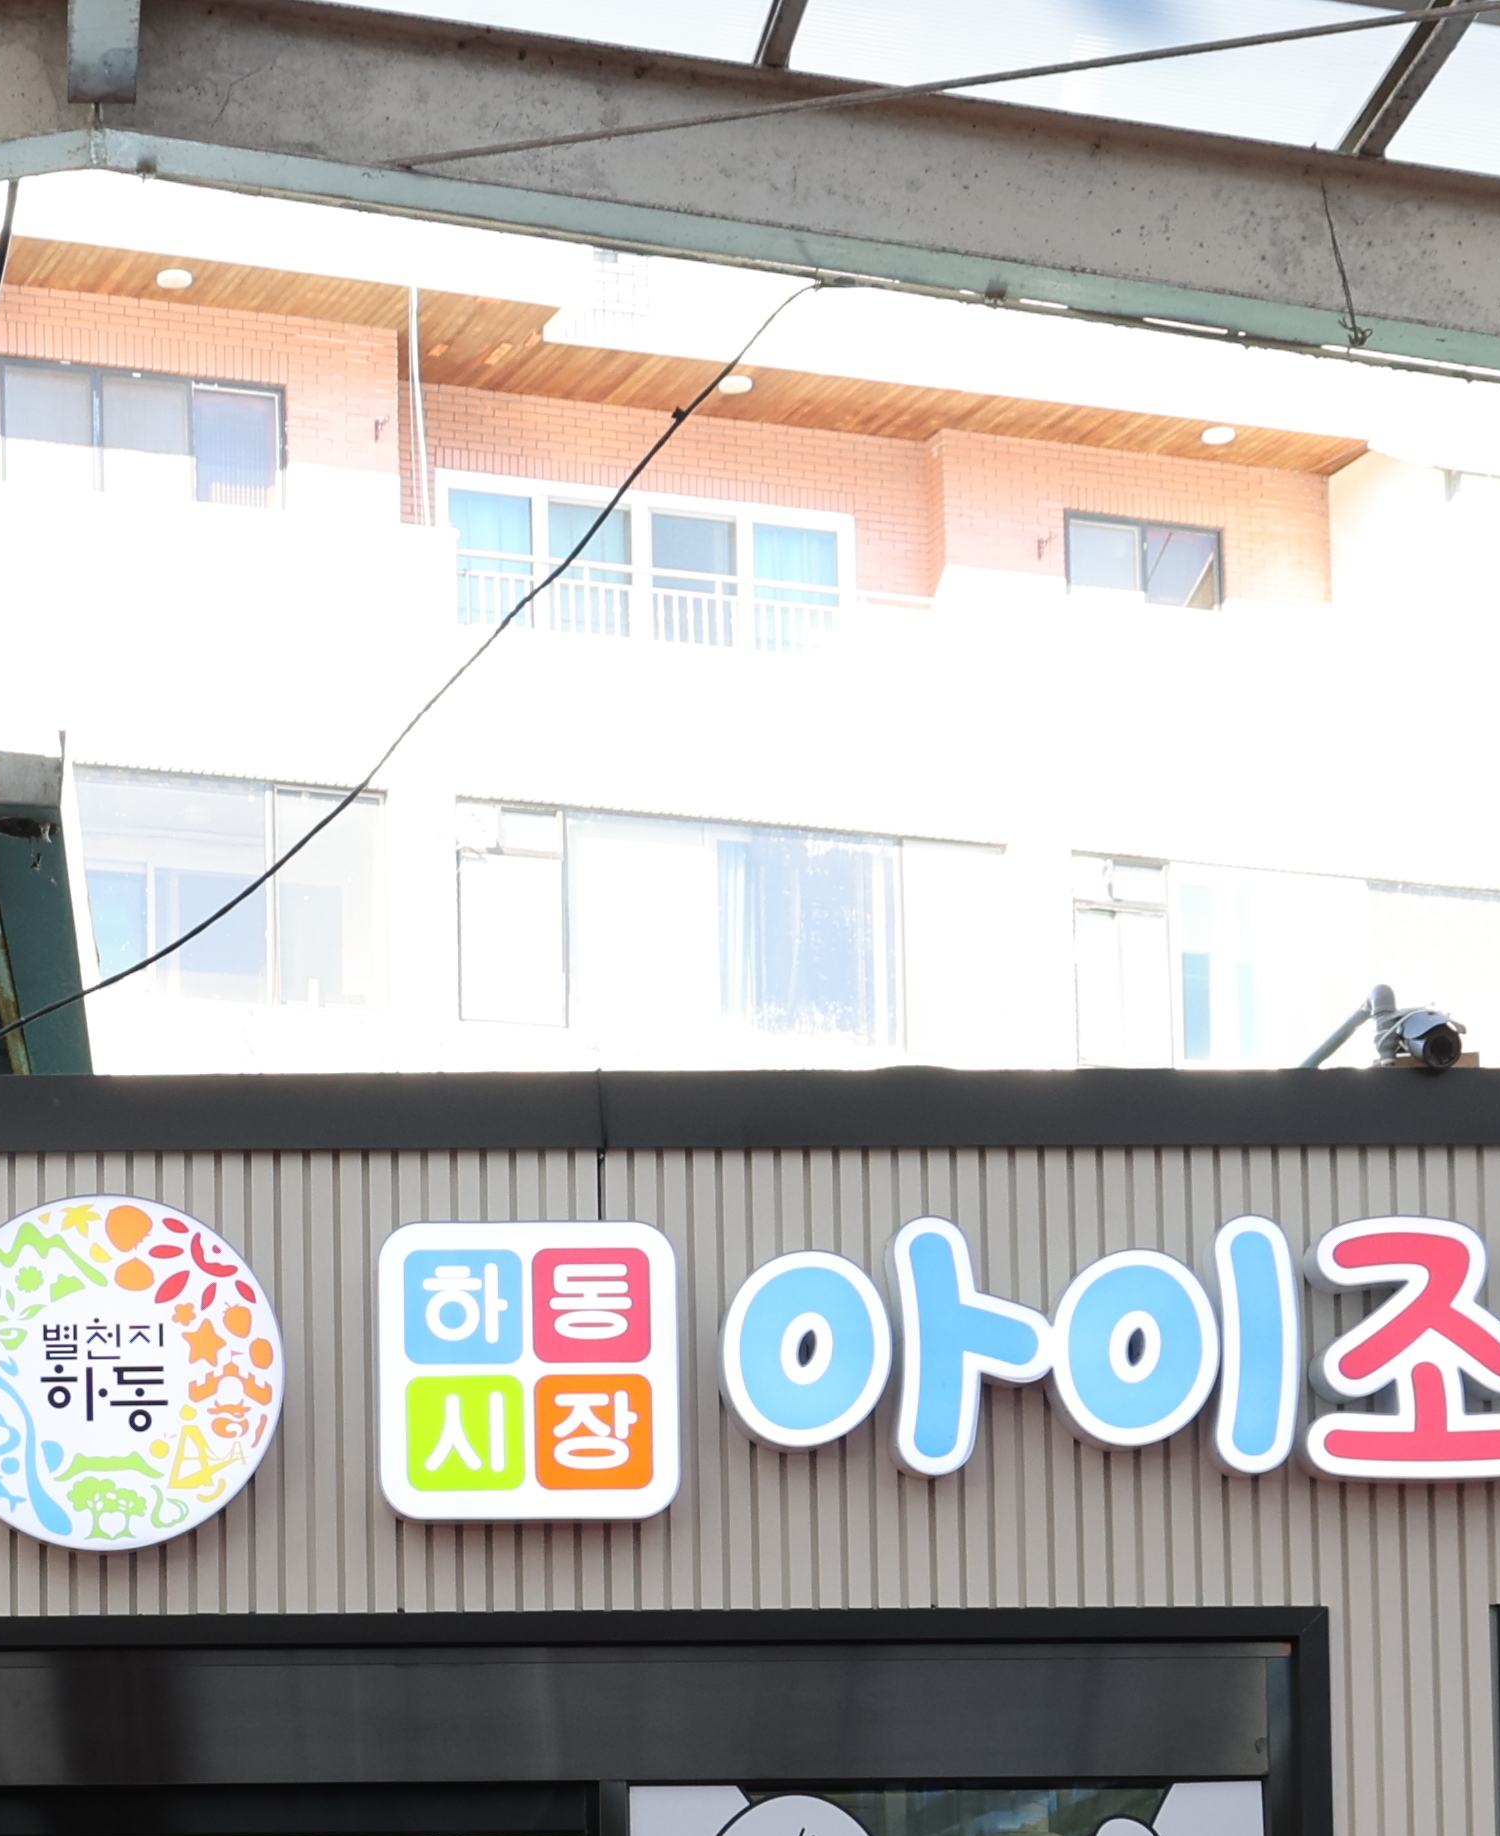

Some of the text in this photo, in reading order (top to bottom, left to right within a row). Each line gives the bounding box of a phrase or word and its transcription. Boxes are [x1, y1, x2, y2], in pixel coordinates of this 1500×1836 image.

[43, 1318, 163, 1360] 별천지
[422, 1262, 633, 1343] 하동
[40, 1364, 168, 1432] 하동
[424, 1389, 638, 1473] 시장
